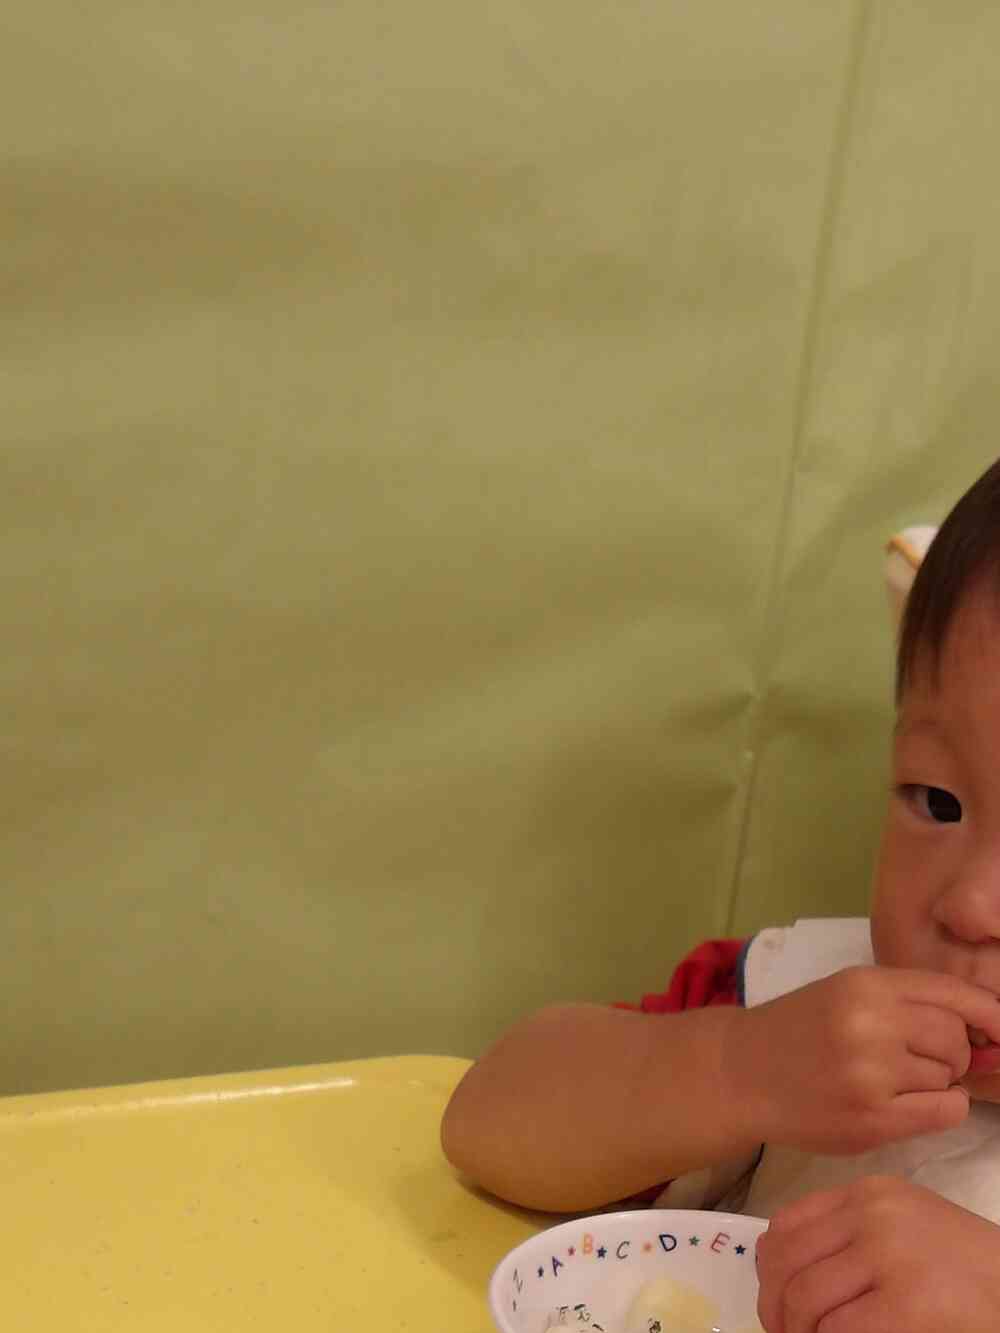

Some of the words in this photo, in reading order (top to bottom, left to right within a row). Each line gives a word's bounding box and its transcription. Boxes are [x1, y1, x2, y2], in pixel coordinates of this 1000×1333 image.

[582, 1233, 593, 1255] B
[615, 1240, 630, 1259] C
[658, 1233, 677, 1252] D
[711, 1231, 731, 1253] E
